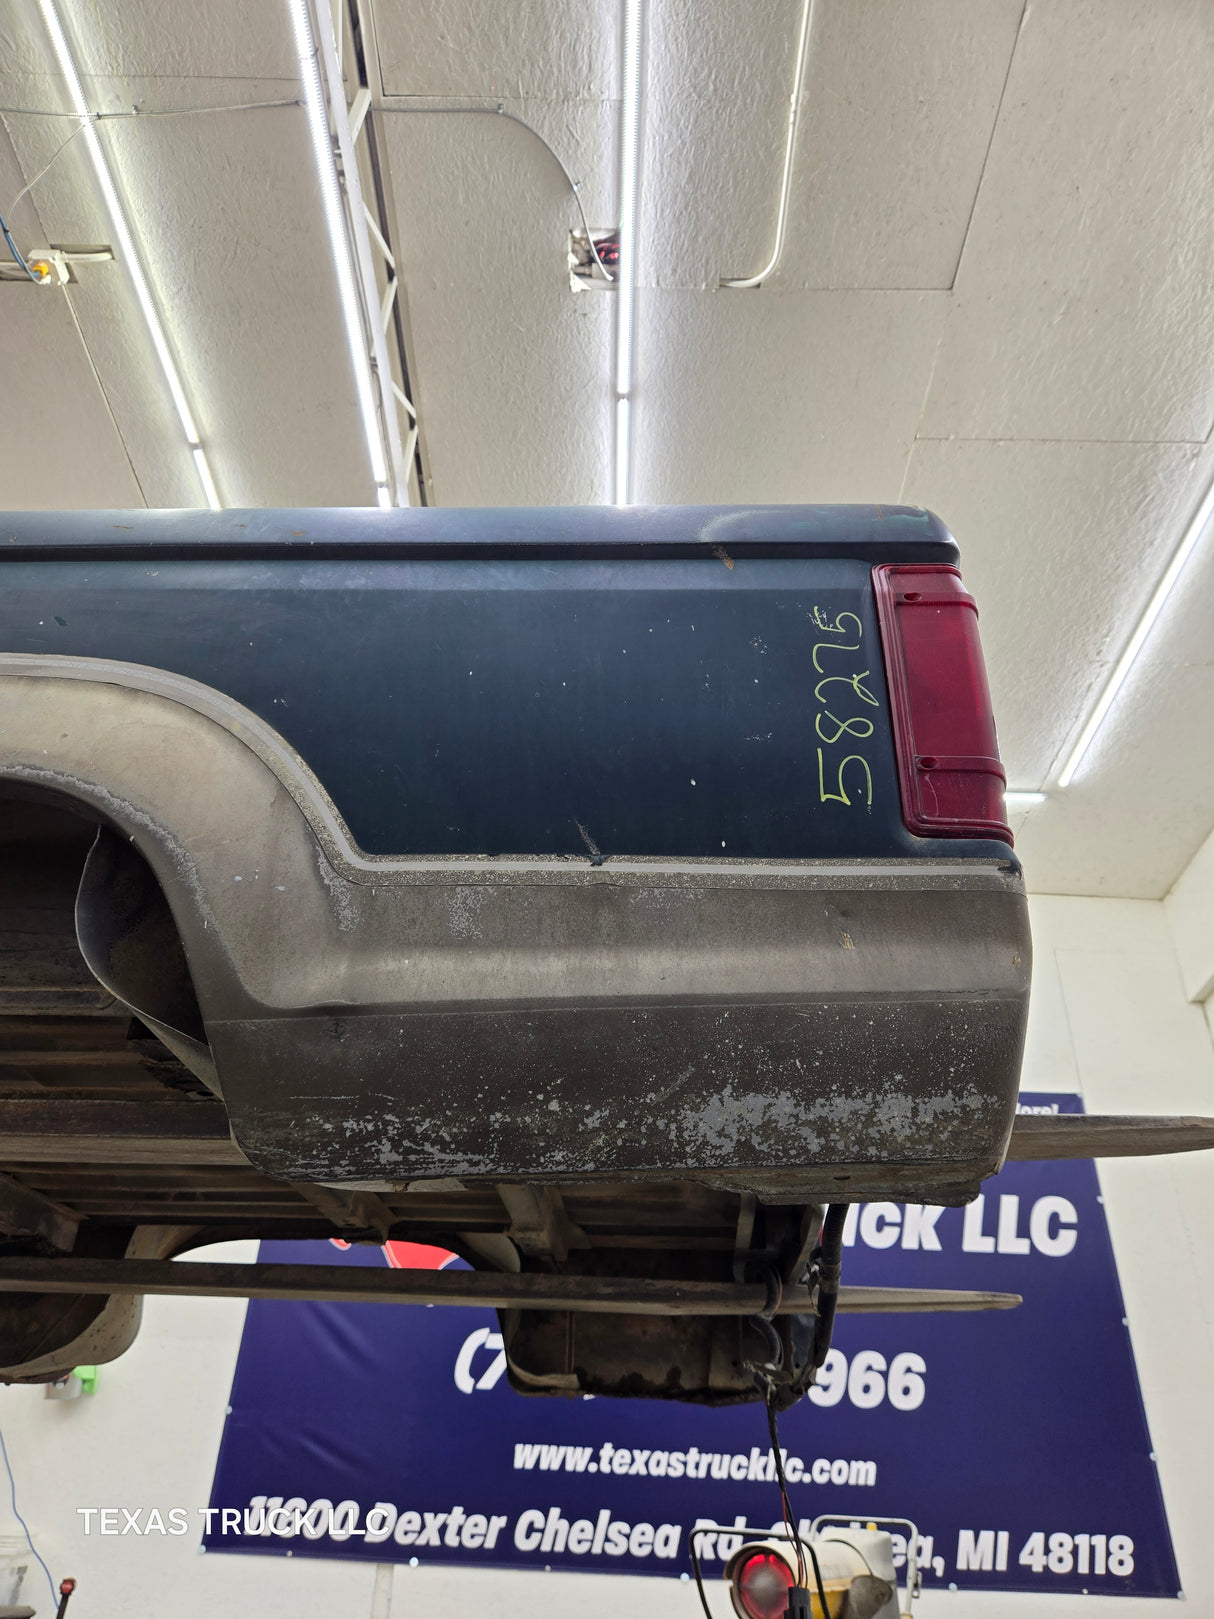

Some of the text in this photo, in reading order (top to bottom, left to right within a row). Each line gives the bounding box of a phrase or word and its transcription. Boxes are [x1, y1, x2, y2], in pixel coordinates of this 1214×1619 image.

[813, 606, 879, 805] 58275
[962, 1194, 1079, 1258] LLC
[513, 1442, 878, 1487] www.texastruckllc.com
[244, 1495, 360, 1542] 11600
[364, 1501, 508, 1550] Dexter
[514, 1507, 682, 1559] Chelsea
[956, 1529, 1009, 1571] MI
[1019, 1532, 1135, 1576] 48118
